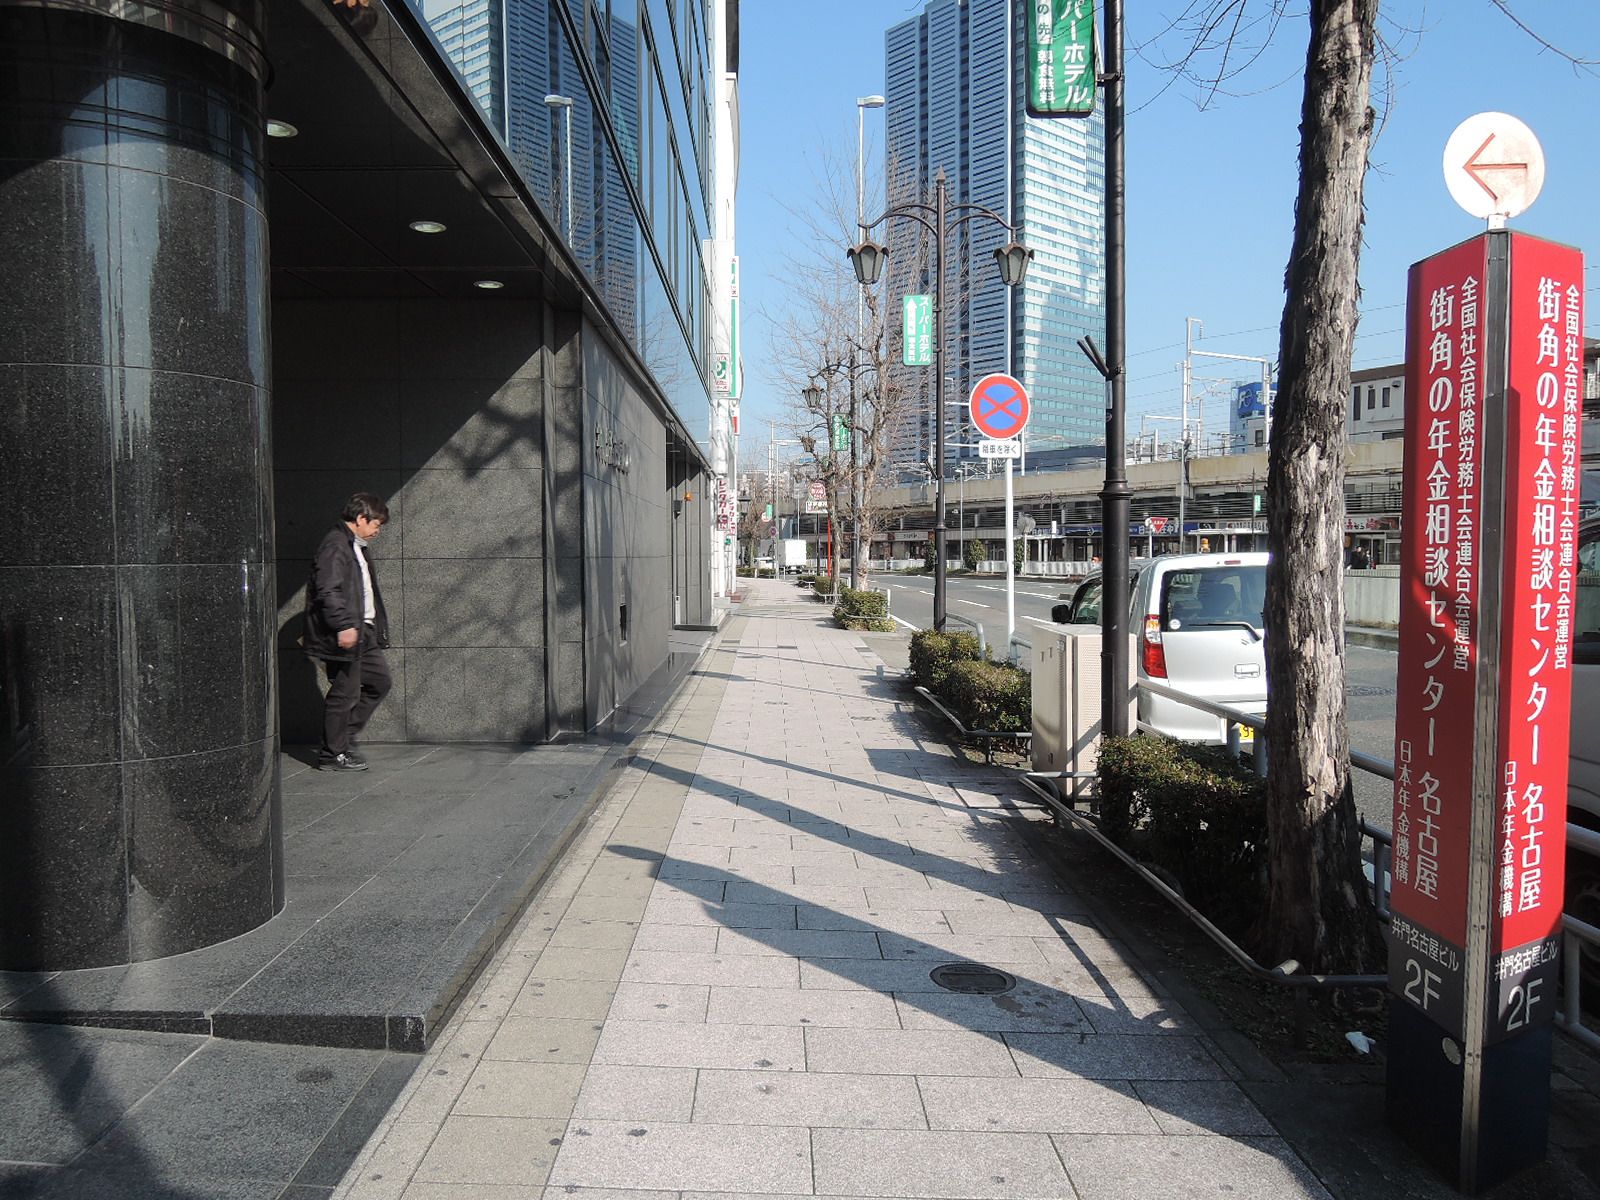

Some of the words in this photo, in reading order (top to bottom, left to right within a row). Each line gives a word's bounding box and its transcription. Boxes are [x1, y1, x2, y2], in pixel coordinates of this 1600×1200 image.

[1421, 283, 1456, 757] 街角の年金相談センター
[1453, 275, 1478, 672] 全国社会保険労務士会連合会運営
[1526, 275, 1561, 766] 街角の年金相談センター
[1553, 284, 1579, 670] 全国社会保険労務士会連合会運営
[1395, 740, 1412, 885] 日本年金機構
[1413, 771, 1442, 901] 名古屋
[1499, 760, 1517, 919] 日本年金機構
[1517, 782, 1544, 913] 名古屋
[1392, 916, 1460, 973] 井門名古屋ビル
[1403, 958, 1443, 1011] 2F
[1494, 940, 1559, 983] 井門名古屋ビル
[1506, 977, 1544, 1032] 2F
